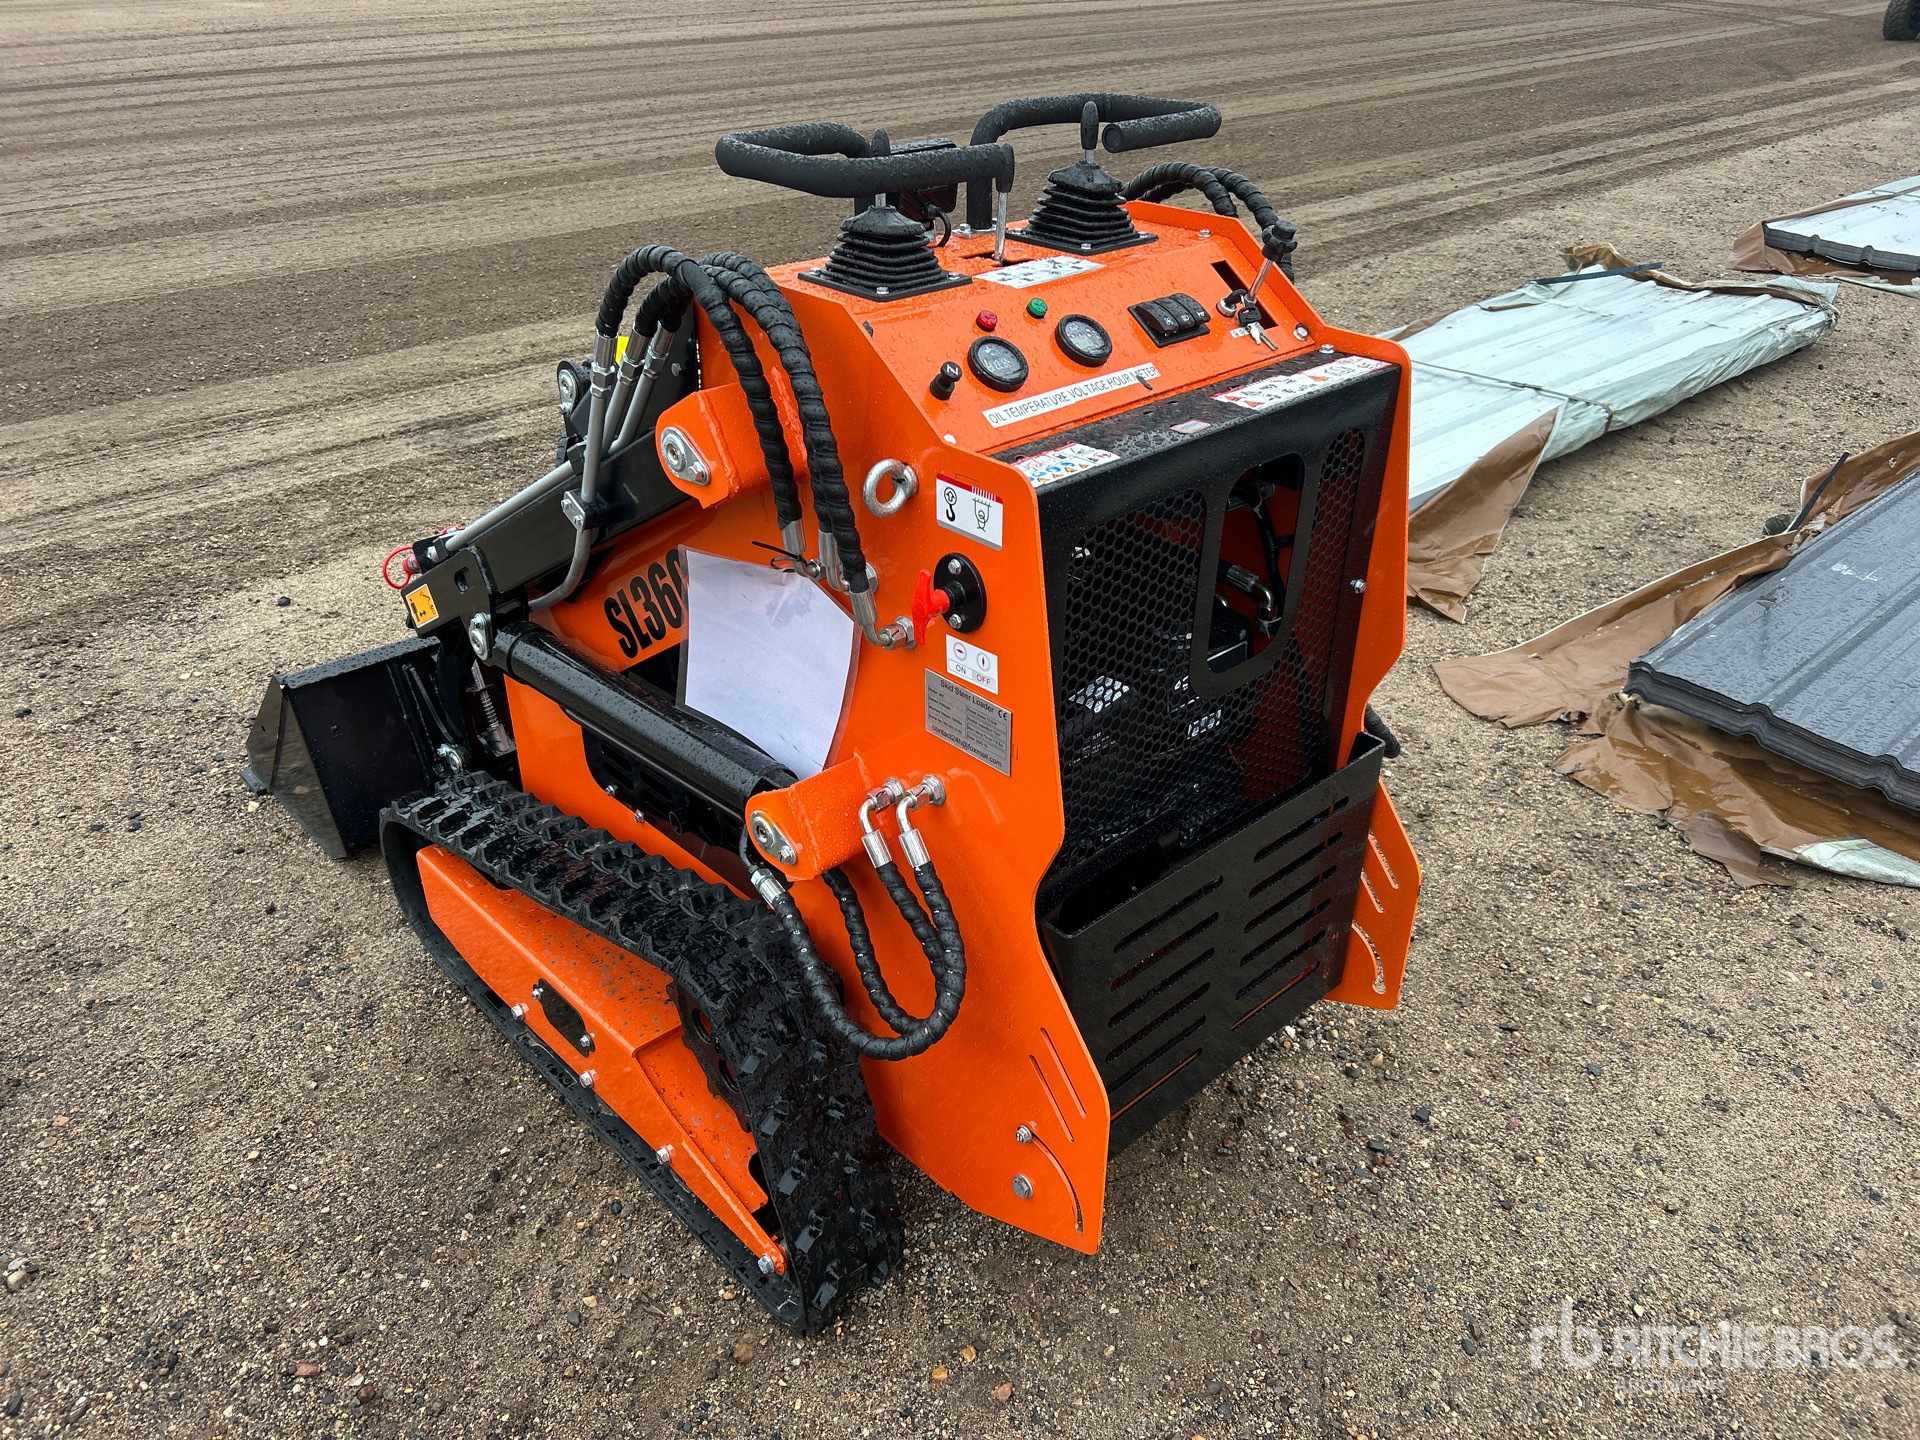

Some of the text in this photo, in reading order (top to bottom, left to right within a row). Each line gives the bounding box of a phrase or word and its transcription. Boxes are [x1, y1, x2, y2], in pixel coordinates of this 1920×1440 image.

[988, 365, 1158, 424] OIL TEMPERATURE VOLTAGE HOUR METER
[956, 664, 966, 674] ON
[976, 674, 990, 686] OFF
[940, 679, 954, 693] Skid
[954, 687, 972, 702] Steer
[972, 695, 995, 713] Loader
